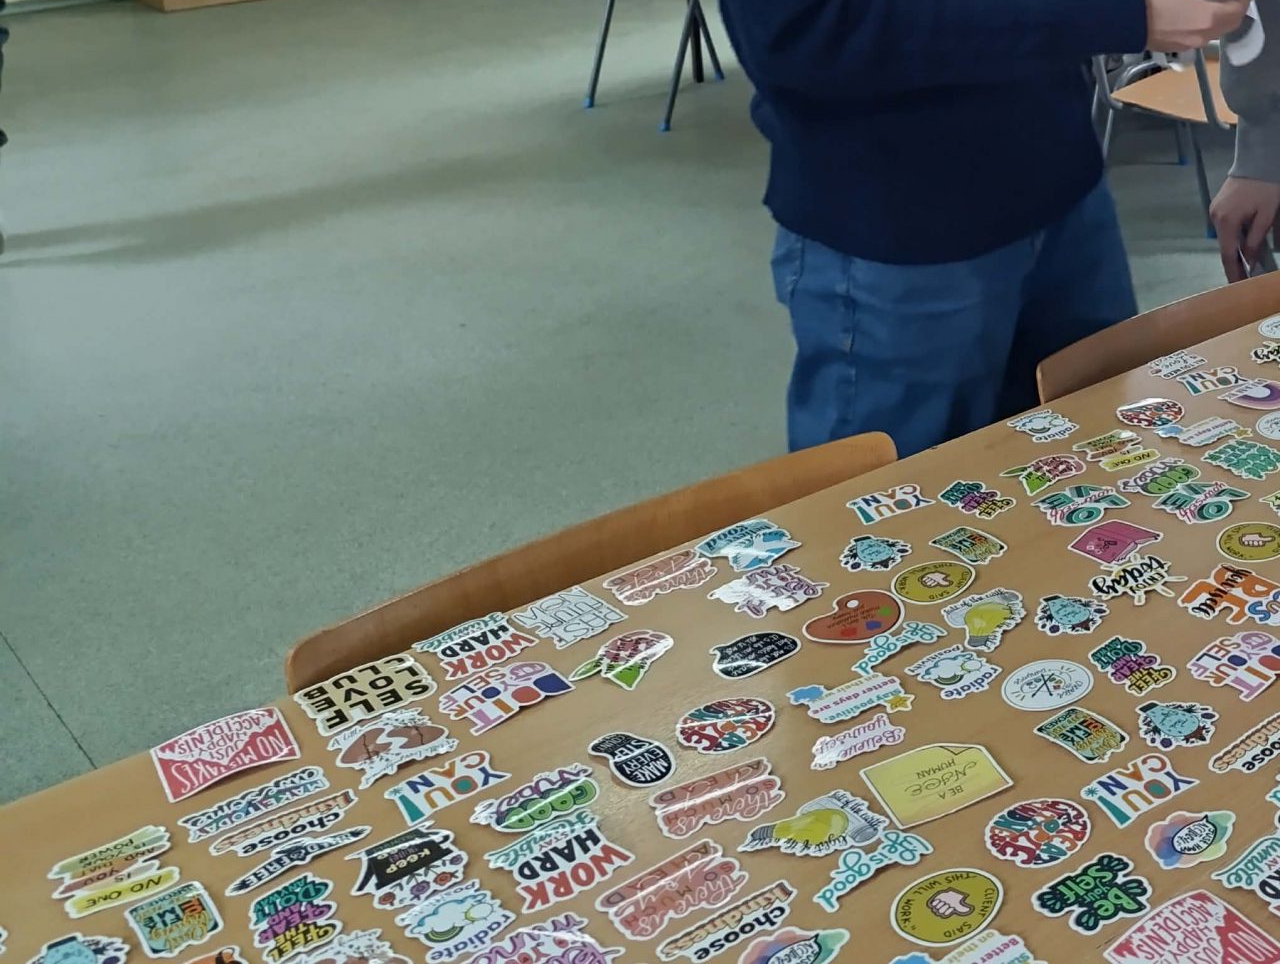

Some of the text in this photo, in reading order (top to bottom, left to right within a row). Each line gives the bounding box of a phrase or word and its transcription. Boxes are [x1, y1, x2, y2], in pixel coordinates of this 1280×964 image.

[857, 495, 931, 523] YOU!
[861, 485, 918, 506] CAN
[1092, 556, 1166, 595] today
[1129, 573, 1165, 594] ENJOY
[441, 626, 508, 657] HARD
[444, 634, 535, 677] WORK
[1189, 638, 1240, 677] SELF
[303, 657, 405, 699] CLUB
[944, 668, 998, 697] radiate
[1128, 668, 1173, 694] FEEL
[1204, 650, 1256, 684] YOUR
[1230, 667, 1272, 698] IT
[311, 666, 419, 712] LOVE
[325, 680, 429, 729] SELF
[441, 669, 506, 706] SELF
[811, 678, 896, 715] Better days are
[469, 700, 515, 728] IT
[170, 729, 285, 793] NO MISTAKES
[208, 740, 241, 760] JUST
[621, 748, 663, 773] EVERY
[838, 729, 901, 759] Believe
[406, 753, 485, 794] CAN
[631, 758, 668, 781] MAKE
[916, 759, 955, 779] HUMAN
[1097, 756, 1167, 796] CAN
[399, 767, 510, 823] YOU!
[504, 781, 595, 829] GOOD
[949, 785, 963, 794] BE
[1097, 772, 1195, 826] YOU!
[241, 813, 340, 854] choose
[538, 833, 568, 850] STAY
[245, 857, 290, 884] FREE
[518, 829, 600, 880] HARD
[82, 867, 119, 886] YOU
[85, 876, 162, 908] NO ONE
[521, 844, 630, 909] WORK
[818, 851, 870, 909] good
[914, 881, 940, 896] WILL
[258, 903, 331, 943] FEAR
[661, 887, 790, 958] kindness
[944, 888, 995, 938] CLIENT SAID
[267, 923, 335, 960] FEEL
[431, 915, 510, 961] radiate
[693, 907, 785, 959] choose
